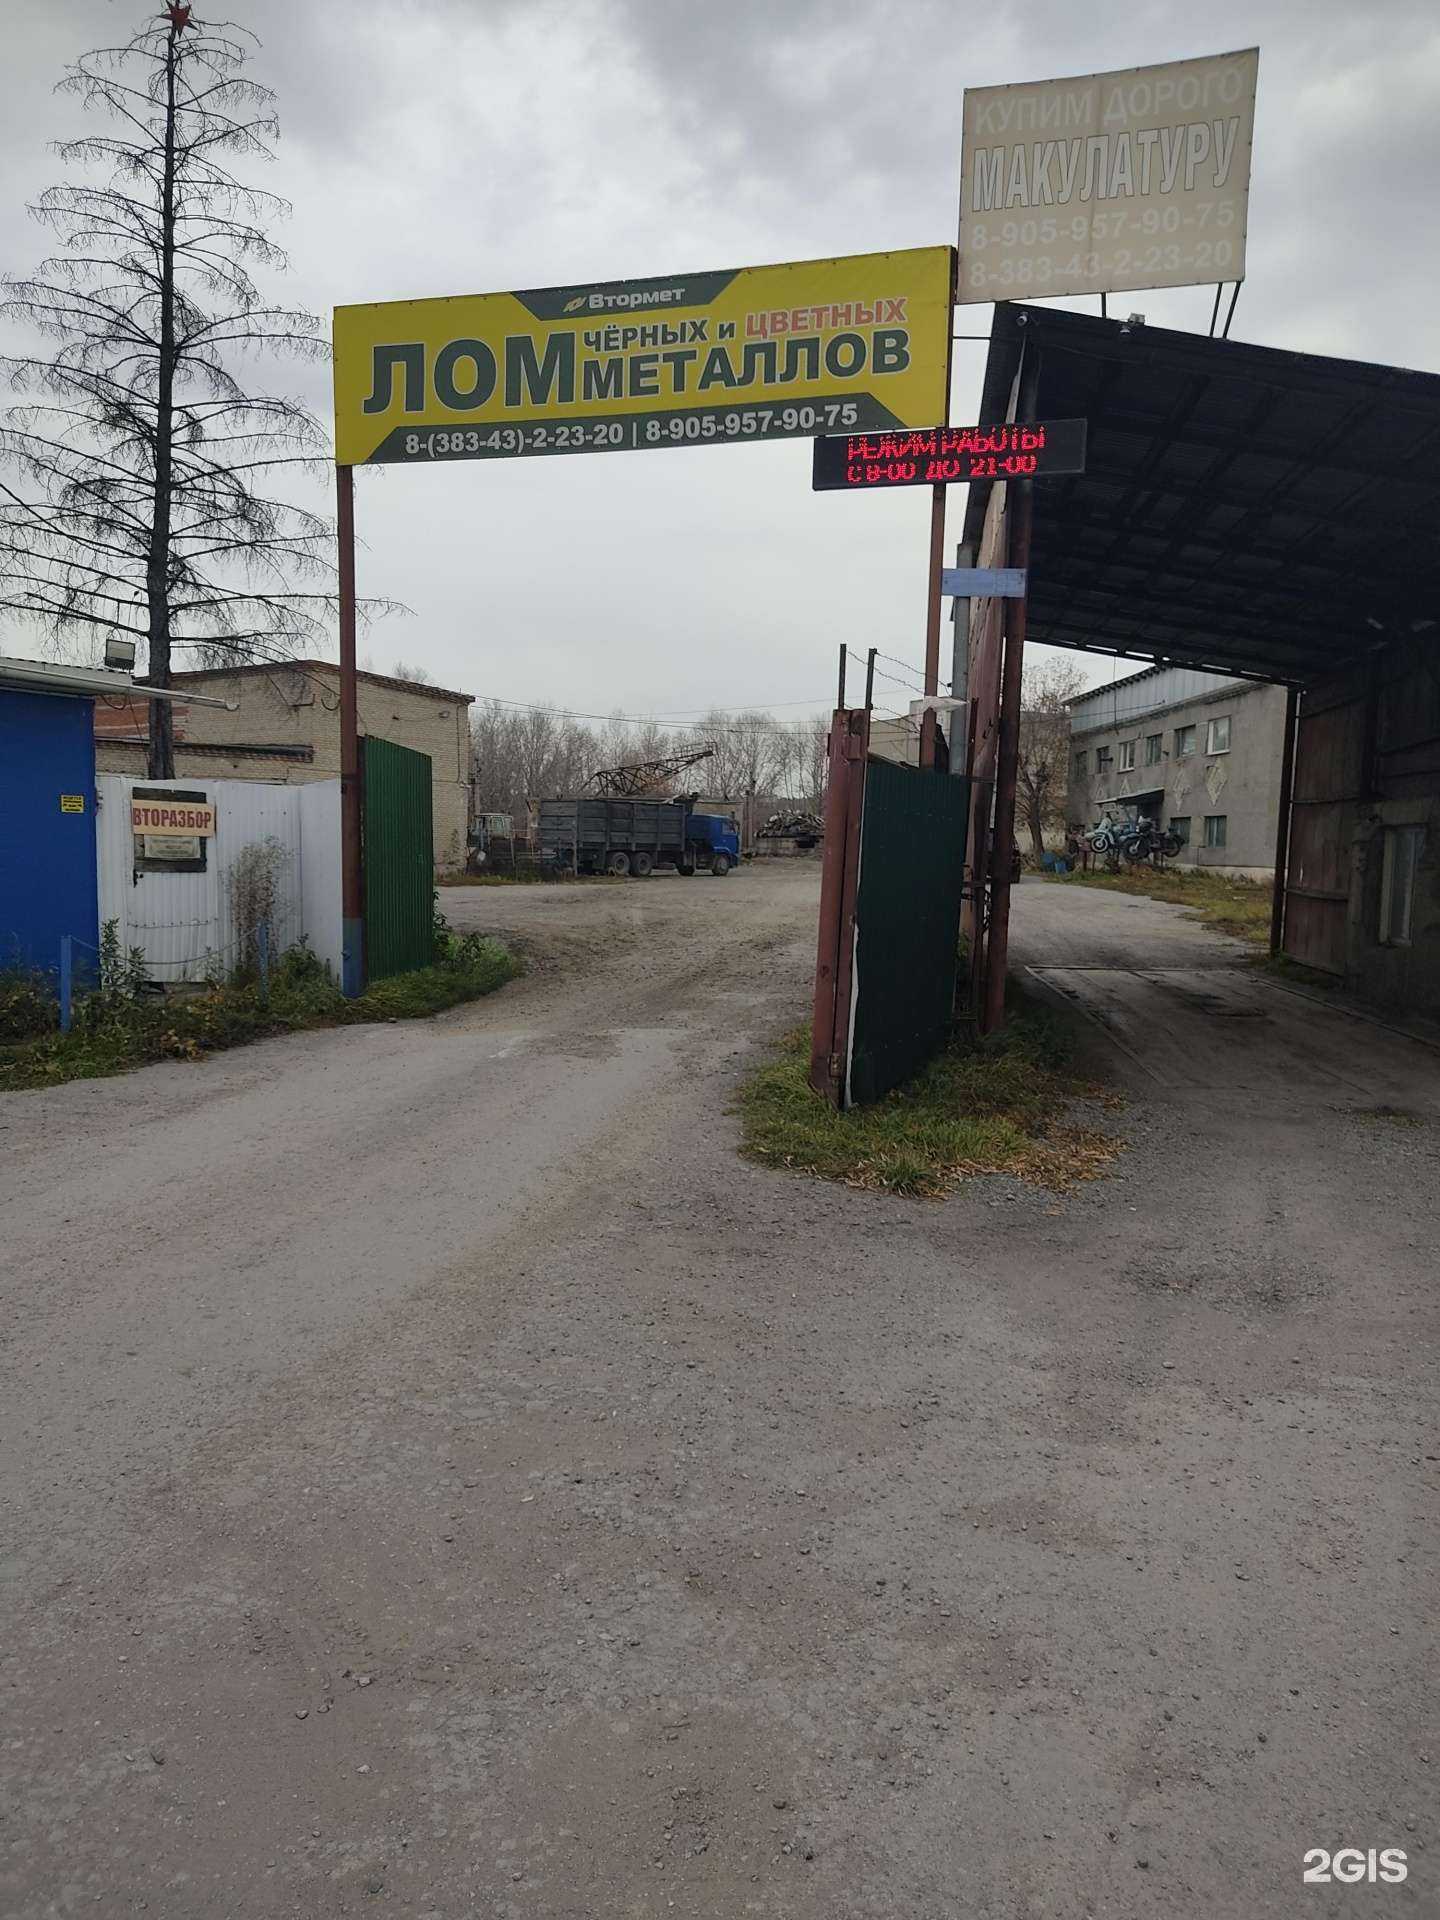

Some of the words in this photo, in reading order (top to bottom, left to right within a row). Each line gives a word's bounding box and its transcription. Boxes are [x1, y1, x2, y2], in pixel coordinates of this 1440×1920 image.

[975, 89, 1091, 134] КУПИМ
[1103, 68, 1243, 125] ДОРОГО
[972, 116, 1241, 212] МАКУЛАТУРУ
[971, 200, 1235, 250] 8-905-957-90-75
[969, 240, 1233, 289] 8-383-43-2-23-20
[583, 319, 708, 352] ЧЁРНЫХ
[717, 321, 736, 341] и
[745, 297, 908, 340] ЦВЕТНЫХ
[588, 287, 686, 311] Втормет
[363, 331, 576, 414] ЛОМ
[583, 328, 911, 402] МЕТАЛЛОВ
[405, 423, 624, 458] 8-(383-43)-2-23-20
[645, 403, 858, 443] 8-905-957-90-75
[132, 807, 212, 829] ВТОРАЗБОР
